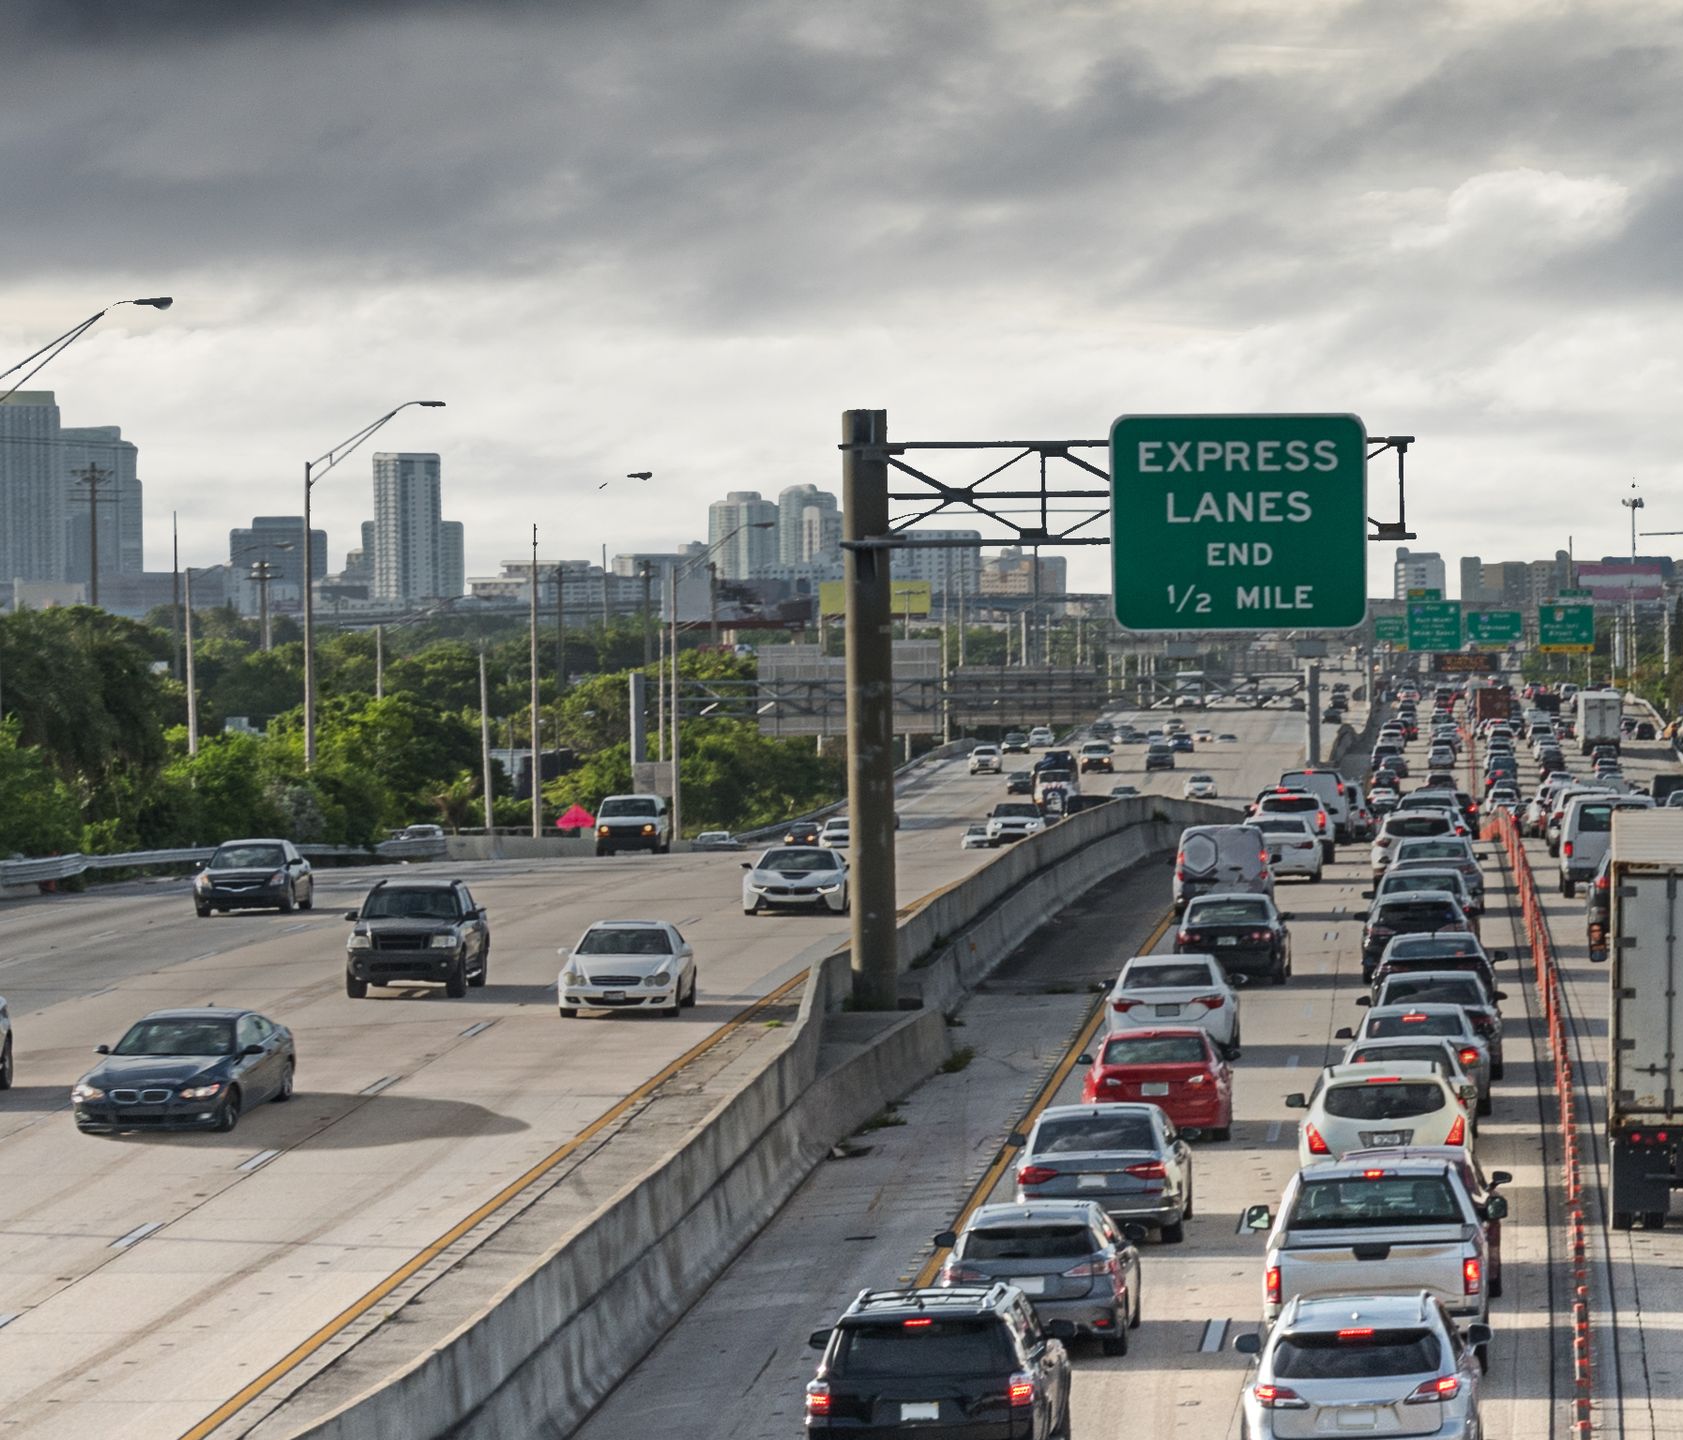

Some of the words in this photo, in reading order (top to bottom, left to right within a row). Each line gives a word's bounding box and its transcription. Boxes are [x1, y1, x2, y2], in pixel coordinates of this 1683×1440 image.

[1138, 440, 1339, 472] EXPRESS
[1166, 491, 1312, 523] LANES
[1206, 543, 1273, 566] END
[1167, 584, 1212, 613] 1/2
[1236, 586, 1314, 609] MILE
